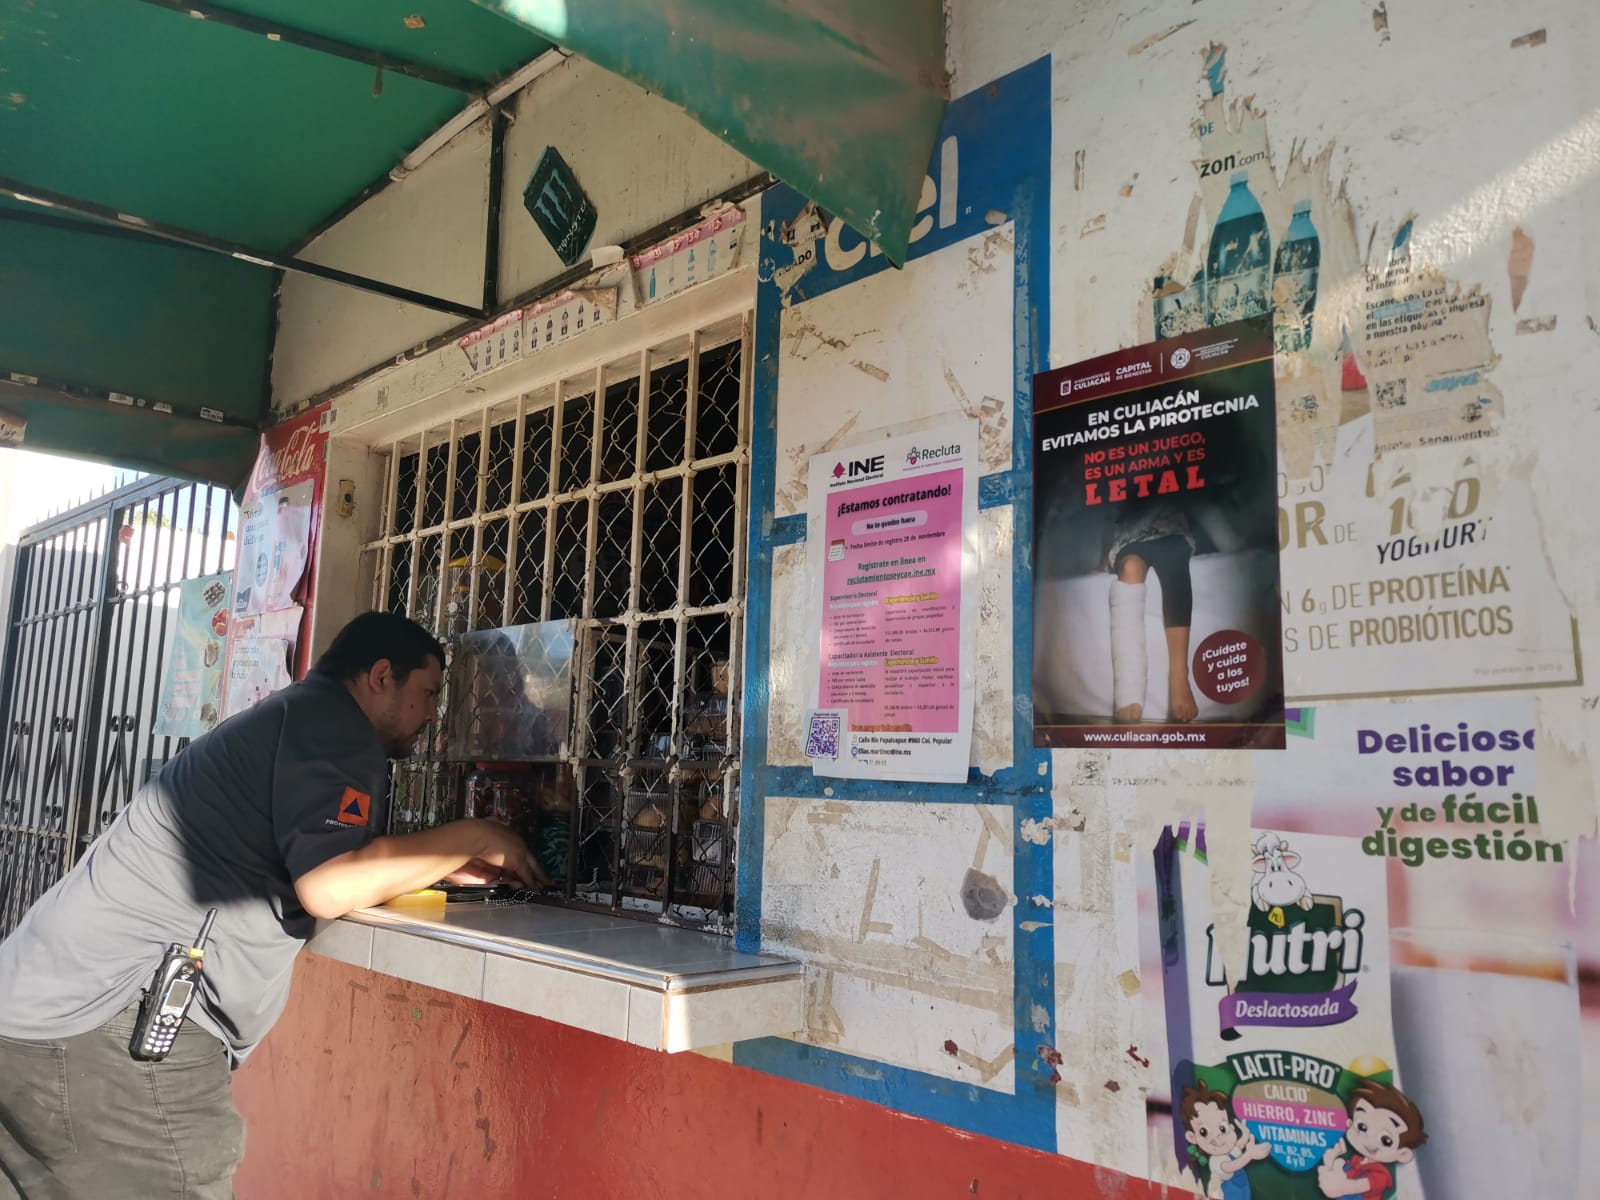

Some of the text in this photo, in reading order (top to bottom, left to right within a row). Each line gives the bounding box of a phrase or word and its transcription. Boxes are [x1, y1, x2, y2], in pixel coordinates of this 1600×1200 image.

[1394, 310, 1438, 324] etiqueas
[1373, 325, 1408, 339] nuestra
[1115, 361, 1153, 375] CAPITAL
[1073, 375, 1111, 390] CULIACÁN
[1088, 389, 1200, 427] EN CULIACÁN
[1042, 394, 1259, 451] EVITAMOS LA PIROTECNIA
[921, 444, 961, 460] Recluta
[1084, 431, 1206, 465] NO ES UN JUEGO,
[849, 455, 885, 477] INE
[1085, 448, 1206, 480] ES UN ARMA Y ES
[1085, 466, 1205, 506] LETAL
[837, 484, 952, 518] ¡Estamos contratando!
[866, 522, 874, 530] No
[875, 521, 881, 529] te
[900, 516, 916, 525] fuera
[1333, 522, 1358, 545] DE
[918, 531, 945, 541] noviembre
[1377, 516, 1493, 565] YOGUR
[917, 555, 926, 563] en
[1332, 582, 1362, 610] DE
[1308, 623, 1340, 651] DE
[1349, 605, 1514, 647] PROBIÓTICOS
[1202, 641, 1248, 661] ¡Cuídate
[1207, 653, 1247, 673] y cuida
[1217, 667, 1243, 680] a los
[1216, 677, 1249, 694] tuyos!
[1083, 731, 1206, 744] www.culiacan.gob.mx
[1393, 760, 1514, 787] sabor
[1376, 792, 1539, 828] y de fácil
[1361, 827, 1563, 867] digestión
[1235, 998, 1339, 1018] Deslactosada
[1263, 1084, 1307, 1103] CALCIO
[1243, 1101, 1336, 1127] HIERRO, ZINC
[1258, 1124, 1327, 1147] VITAMINAS
